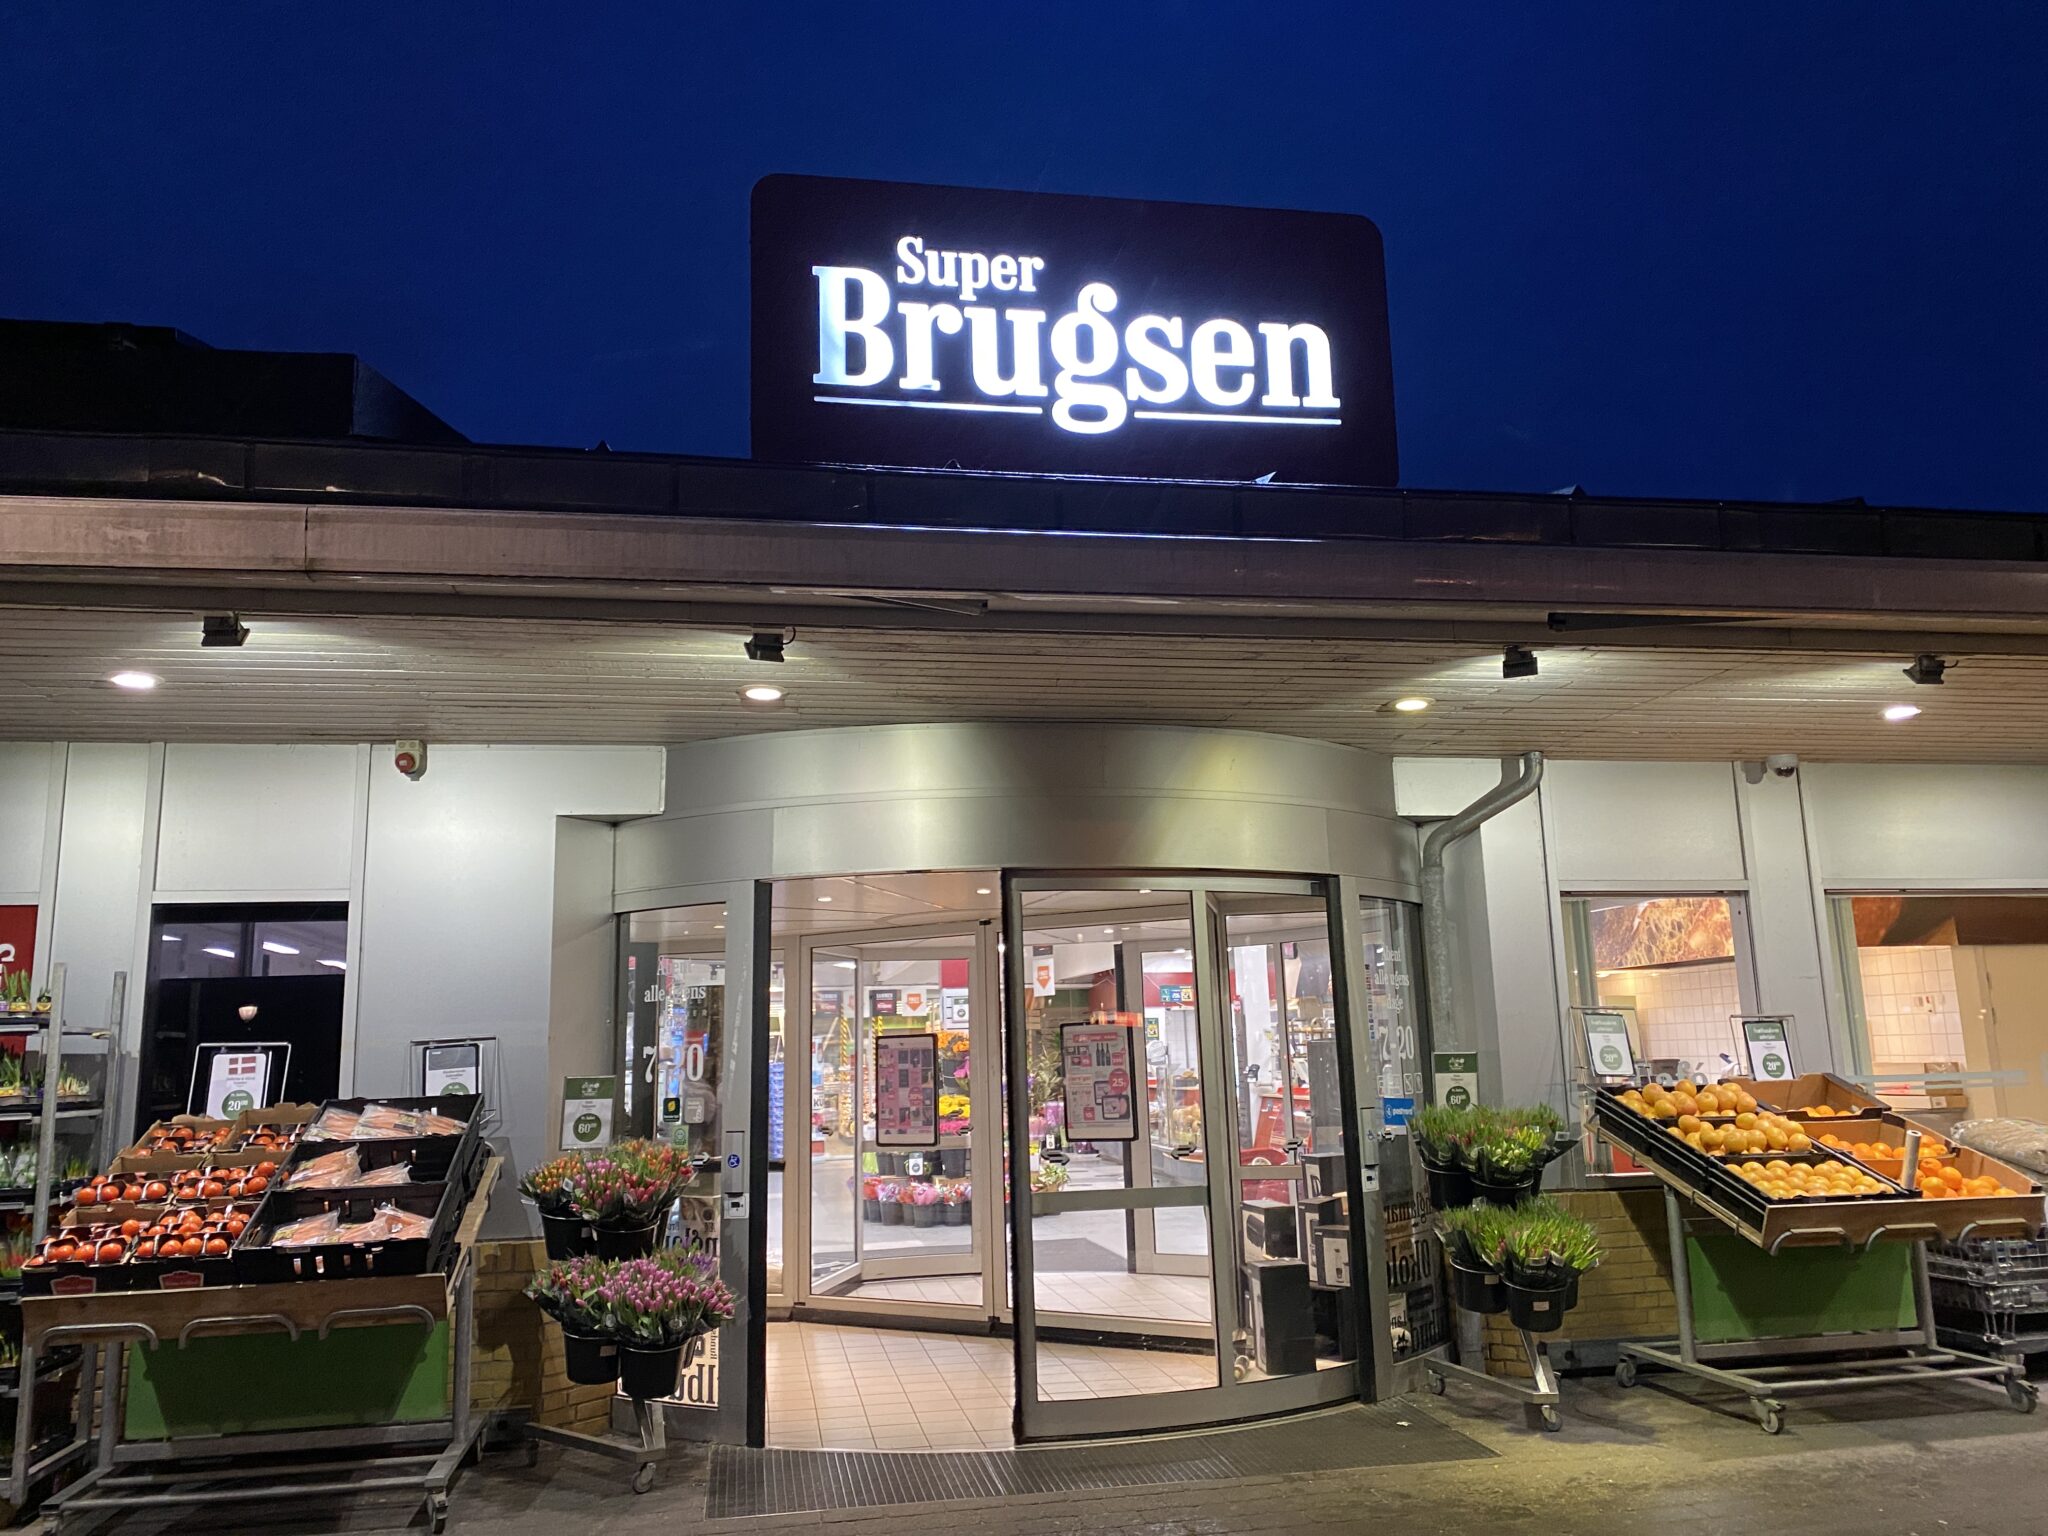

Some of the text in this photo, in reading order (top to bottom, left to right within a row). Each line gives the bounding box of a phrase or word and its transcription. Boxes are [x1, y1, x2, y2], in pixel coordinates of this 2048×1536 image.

[897, 235, 1045, 301] Super
[812, 265, 1341, 435] Brugsen
[644, 984, 666, 1003] alle
[1374, 969, 1389, 985] alle
[1378, 1025, 1415, 1061] 7-20
